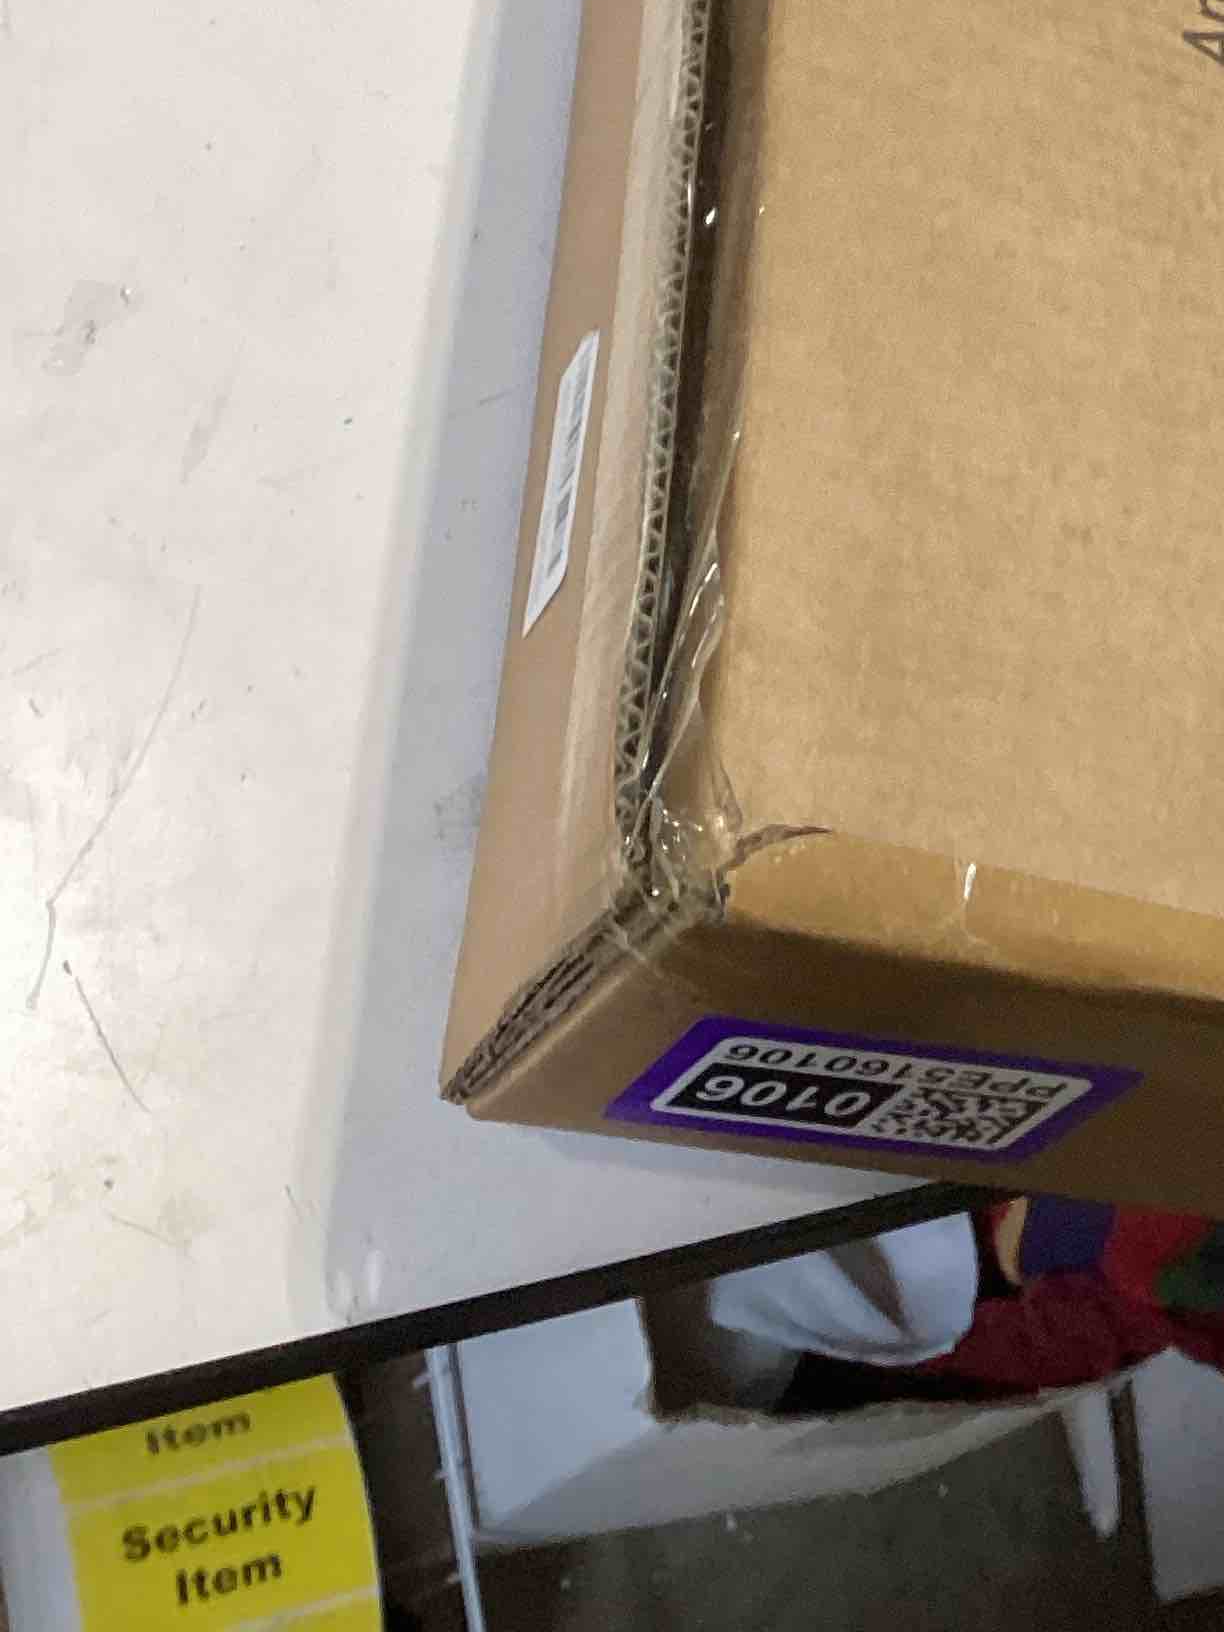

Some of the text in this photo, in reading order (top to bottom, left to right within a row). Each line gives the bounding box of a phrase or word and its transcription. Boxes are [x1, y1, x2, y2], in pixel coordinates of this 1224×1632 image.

[695, 1074, 873, 1119] 0106
[726, 1043, 1069, 1099] PPE5160106
[144, 1411, 253, 1456] Item
[121, 1484, 317, 1563] Security
[174, 1552, 283, 1606] Item
